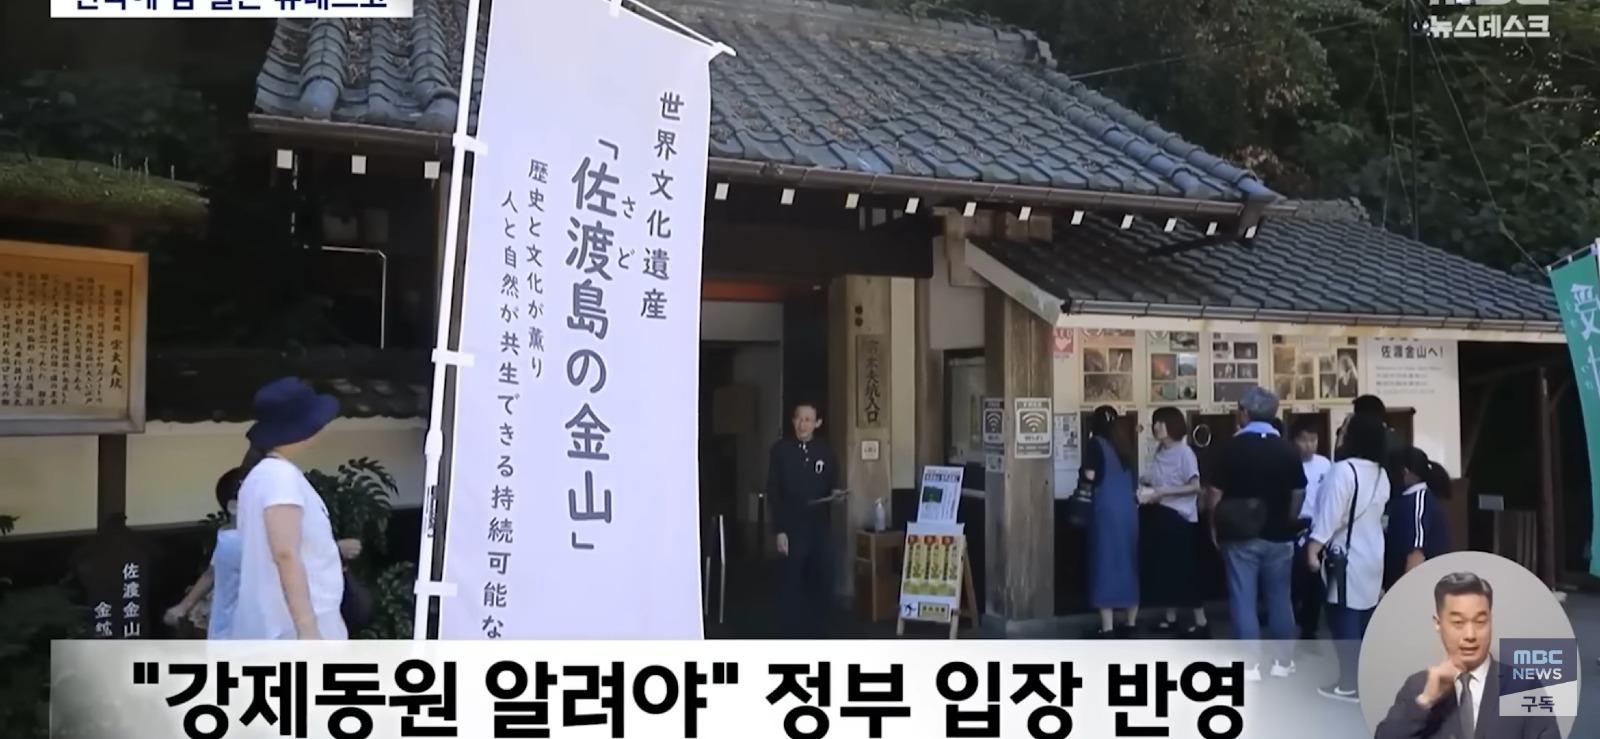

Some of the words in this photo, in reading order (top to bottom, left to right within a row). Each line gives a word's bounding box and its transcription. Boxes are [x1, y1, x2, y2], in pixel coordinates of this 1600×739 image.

[525, 158, 549, 379] 歴史と文化が薫り
[639, 91, 686, 321] 世界文化遺産
[481, 189, 521, 639] 人と自然が共生できる持続可能な
[564, 138, 620, 551] 「佐渡島の金山」
[122, 562, 141, 638] 佐渡金山
